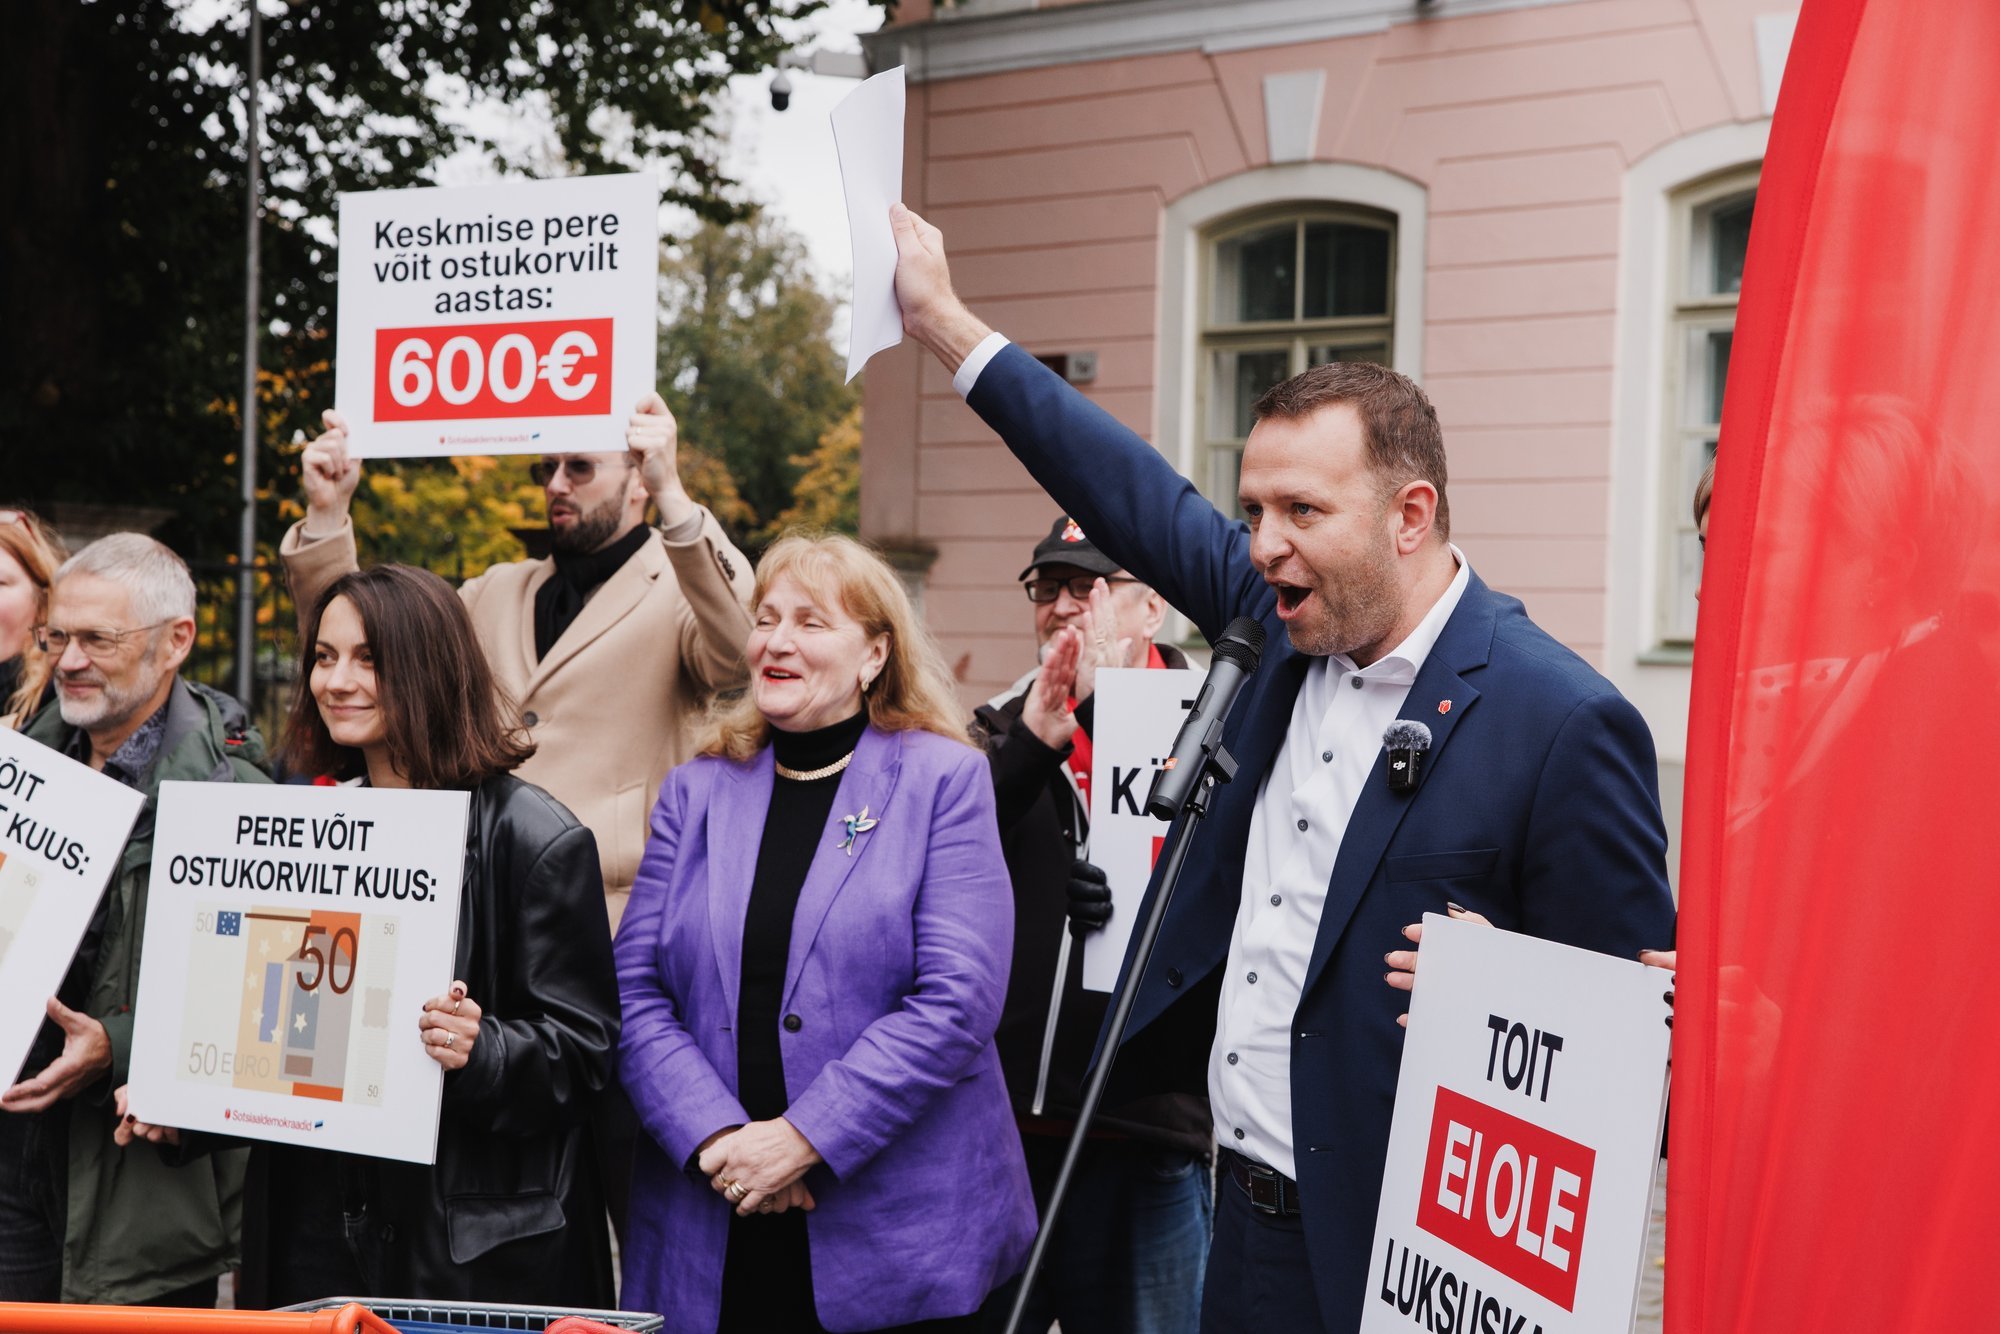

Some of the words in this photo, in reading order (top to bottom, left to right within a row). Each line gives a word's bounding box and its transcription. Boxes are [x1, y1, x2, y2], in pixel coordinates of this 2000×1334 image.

[375, 215, 534, 249] Keskmise
[544, 213, 619, 246] pere
[374, 253, 432, 282] võit
[441, 242, 618, 279] ostukorvilt
[435, 285, 553, 314] aastas:
[388, 330, 599, 408] 600€
[0, 757, 45, 802] ÕIT
[6, 813, 90, 876] KUUS:
[236, 816, 305, 848] PERE
[311, 813, 374, 852] VÕIT
[170, 855, 349, 896] OSTUKORVILT
[353, 865, 437, 902] KUUS:
[196, 912, 214, 932] 50
[383, 923, 395, 935] 50
[296, 925, 358, 995] 50
[188, 1042, 217, 1076] 50
[221, 1052, 270, 1078] EURO
[1486, 1014, 1564, 1103] TOIT
[367, 1084, 379, 1098] 50
[232, 1110, 312, 1131] Sotsiaaldemokraadid
[1436, 1119, 1483, 1221] EI
[1485, 1142, 1582, 1273] OLE
